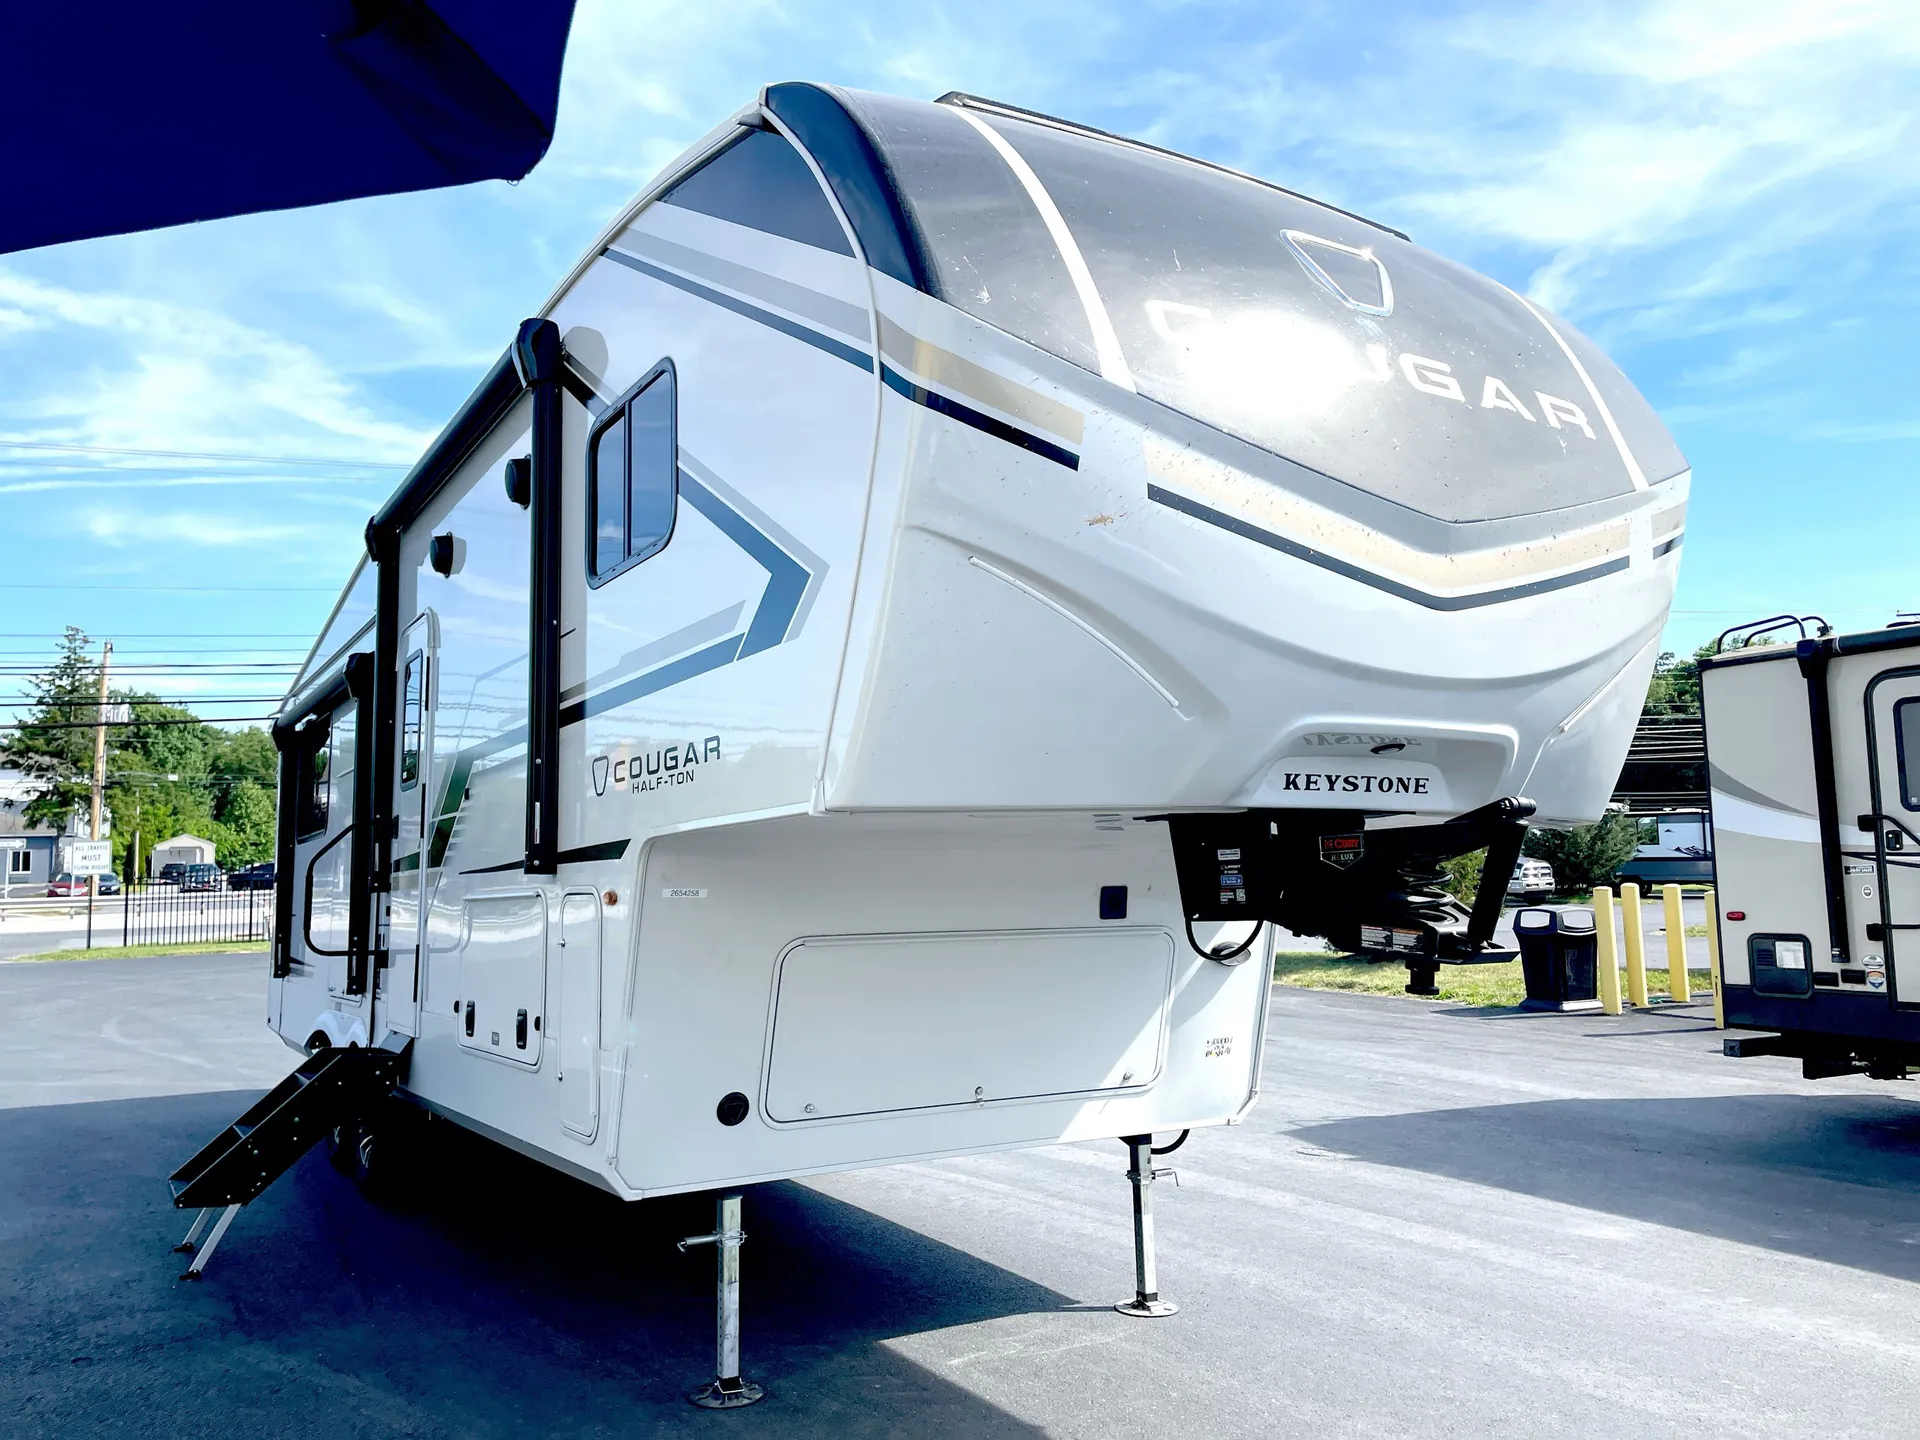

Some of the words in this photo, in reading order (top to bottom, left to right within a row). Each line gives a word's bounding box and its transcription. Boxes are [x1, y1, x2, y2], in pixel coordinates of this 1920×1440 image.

[1144, 299, 1597, 440] CGAR
[614, 735, 721, 783] COUGAR
[632, 769, 694, 794] HALF-TON
[1282, 773, 1430, 794] KEYSTONE
[670, 889, 699, 897] 2654258
